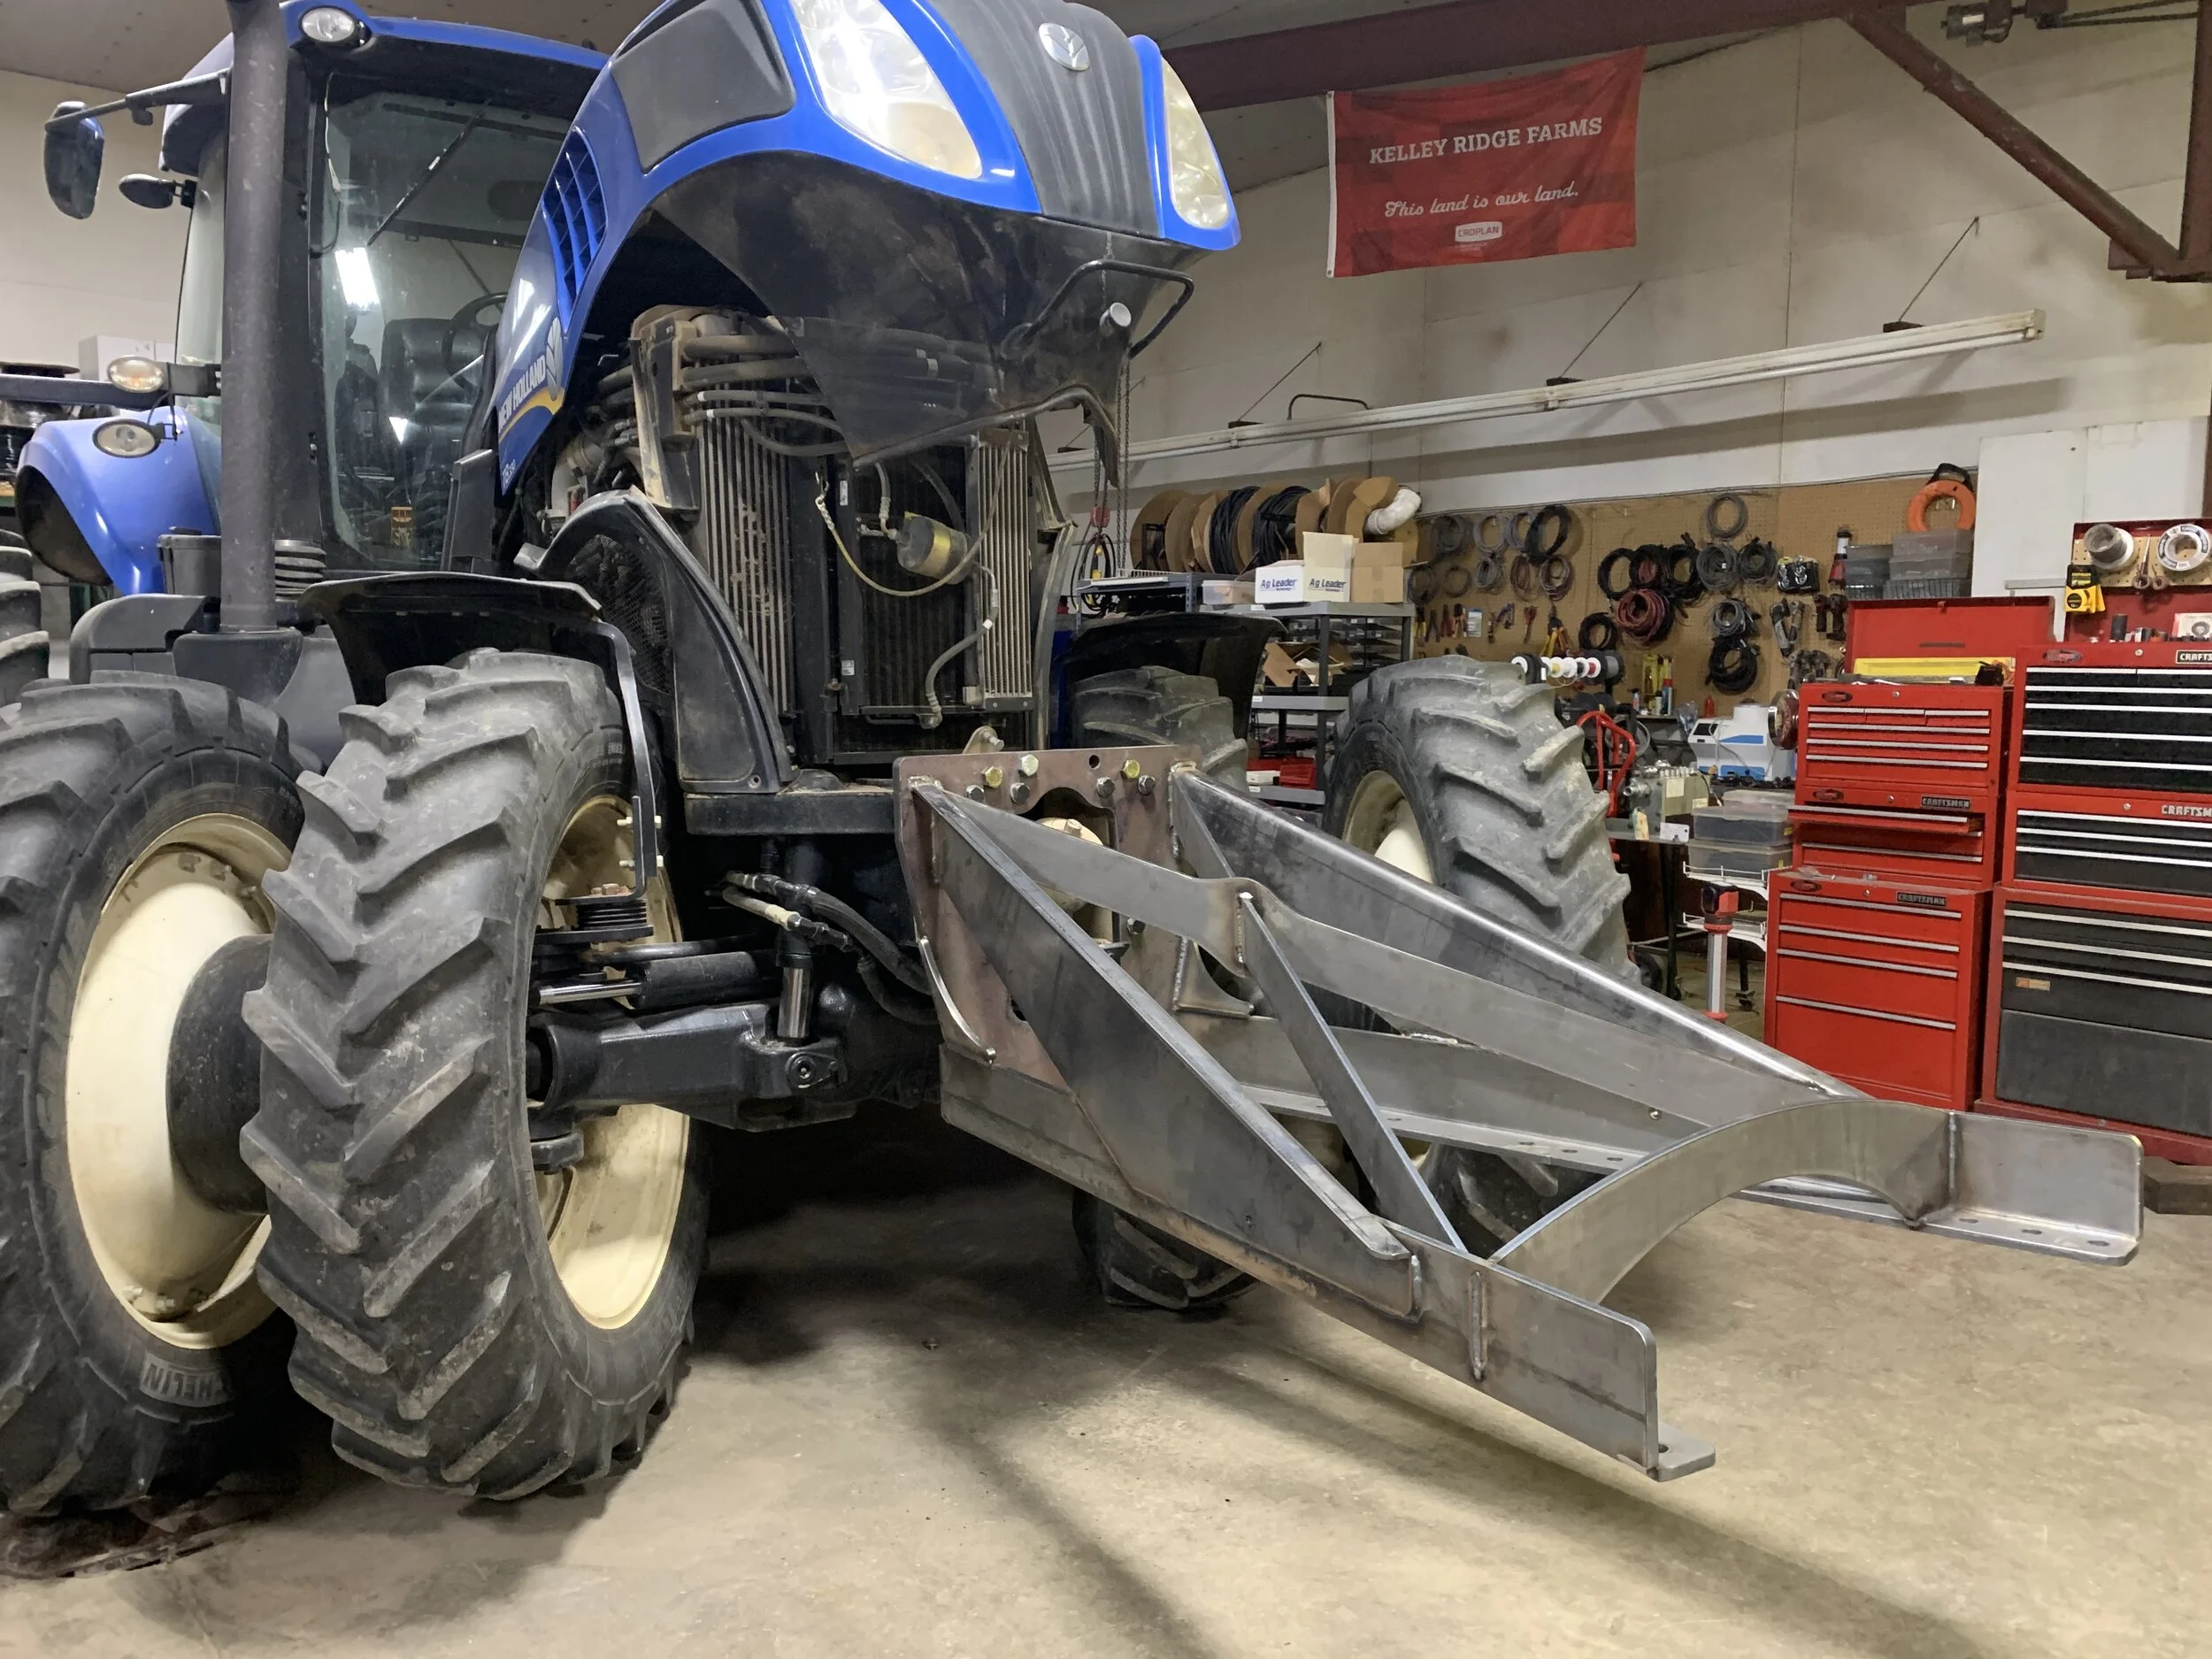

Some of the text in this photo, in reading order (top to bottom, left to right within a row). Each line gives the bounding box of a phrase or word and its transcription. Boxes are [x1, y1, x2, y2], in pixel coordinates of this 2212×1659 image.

[1370, 117, 1603, 164] KELLEY RIDGE FARMS
[1385, 180, 1578, 218] This land is our land.
[1458, 227, 1500, 237] CROPLAN
[498, 355, 546, 434] NEW HOLLAND
[1261, 578, 1298, 588] Ag Leader
[1310, 579, 1346, 588] Ag Leader
[1923, 797, 1970, 808] CRAFTSMAN
